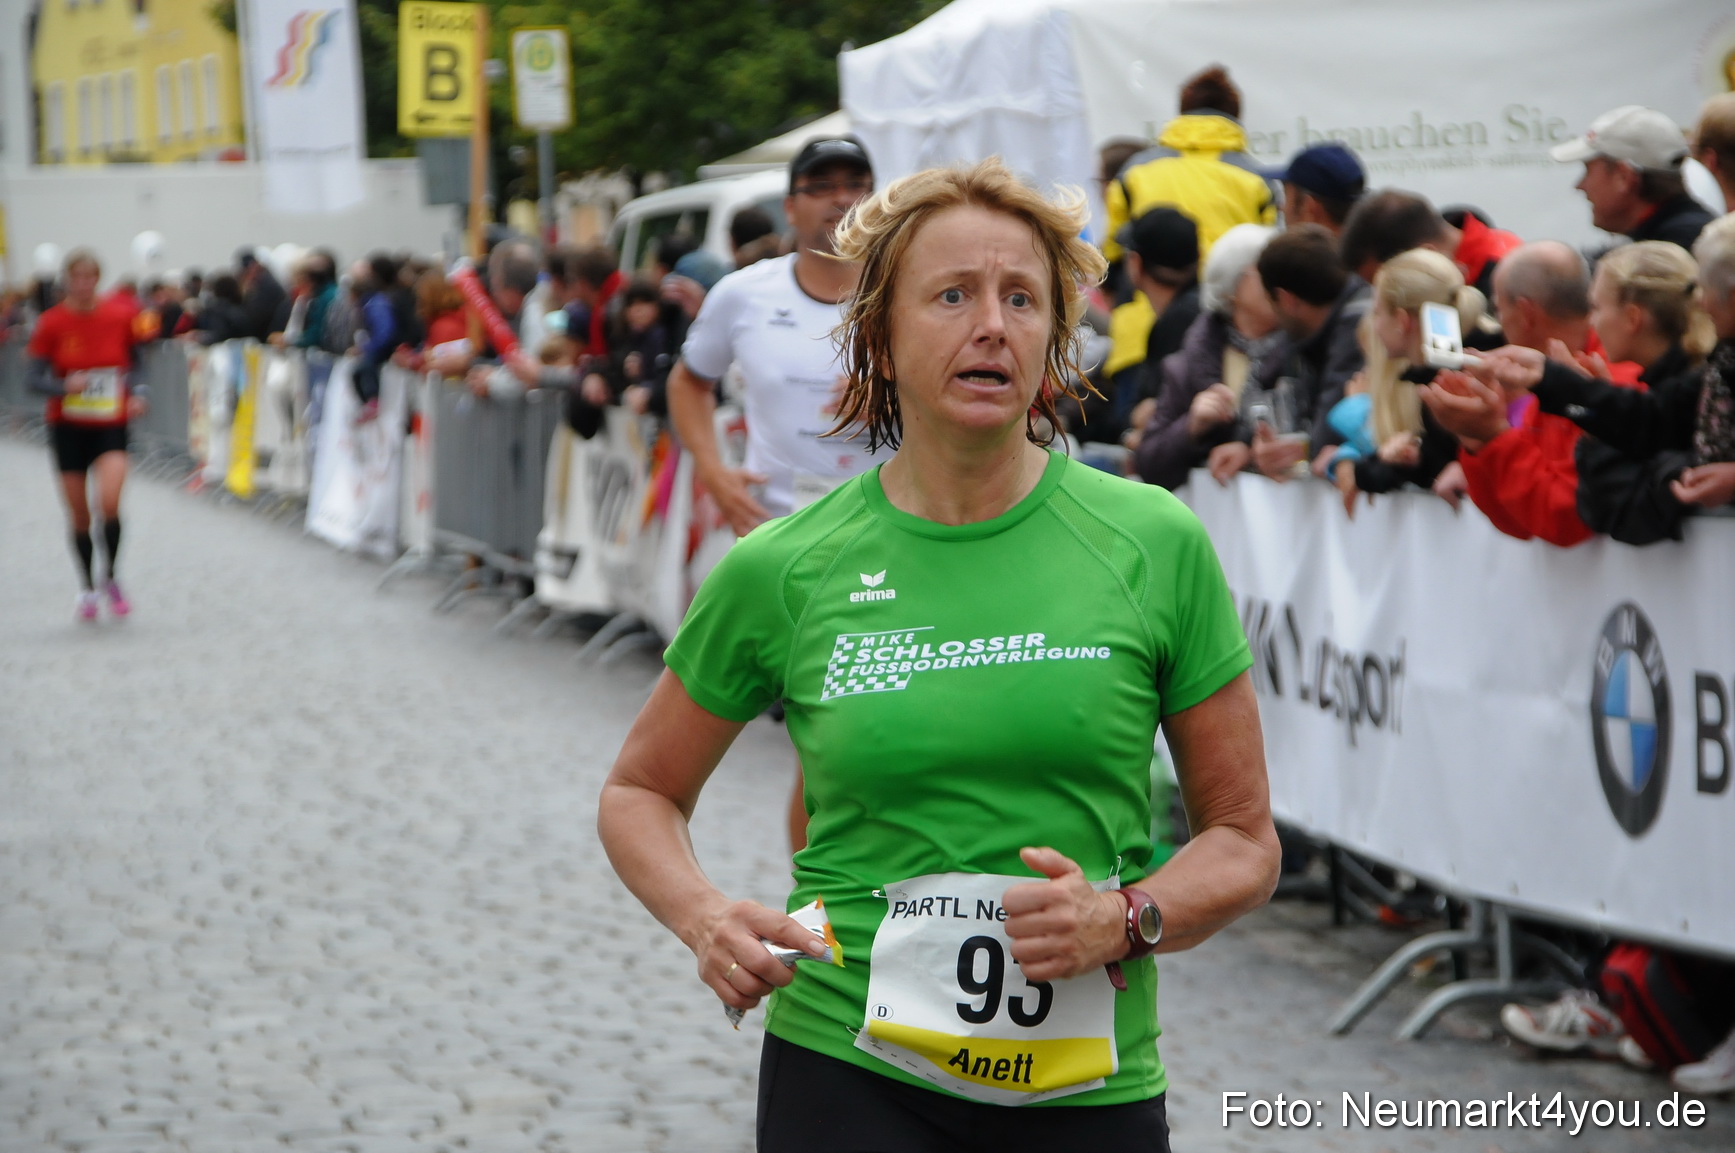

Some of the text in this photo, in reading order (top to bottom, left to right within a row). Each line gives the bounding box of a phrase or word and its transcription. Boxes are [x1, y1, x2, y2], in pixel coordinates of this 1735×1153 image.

[425, 45, 461, 103] B
[849, 588, 896, 603] erima
[854, 632, 1046, 664] SCHLOSSER
[860, 633, 915, 647] MIKE
[848, 646, 1111, 678] FUSSBODENVERLEGUNG
[1695, 672, 1735, 795] B
[891, 896, 1008, 922] PARTL Ne
[956, 935, 1054, 1028] 93
[877, 1006, 887, 1018] D
[948, 1048, 1034, 1084] Anett
